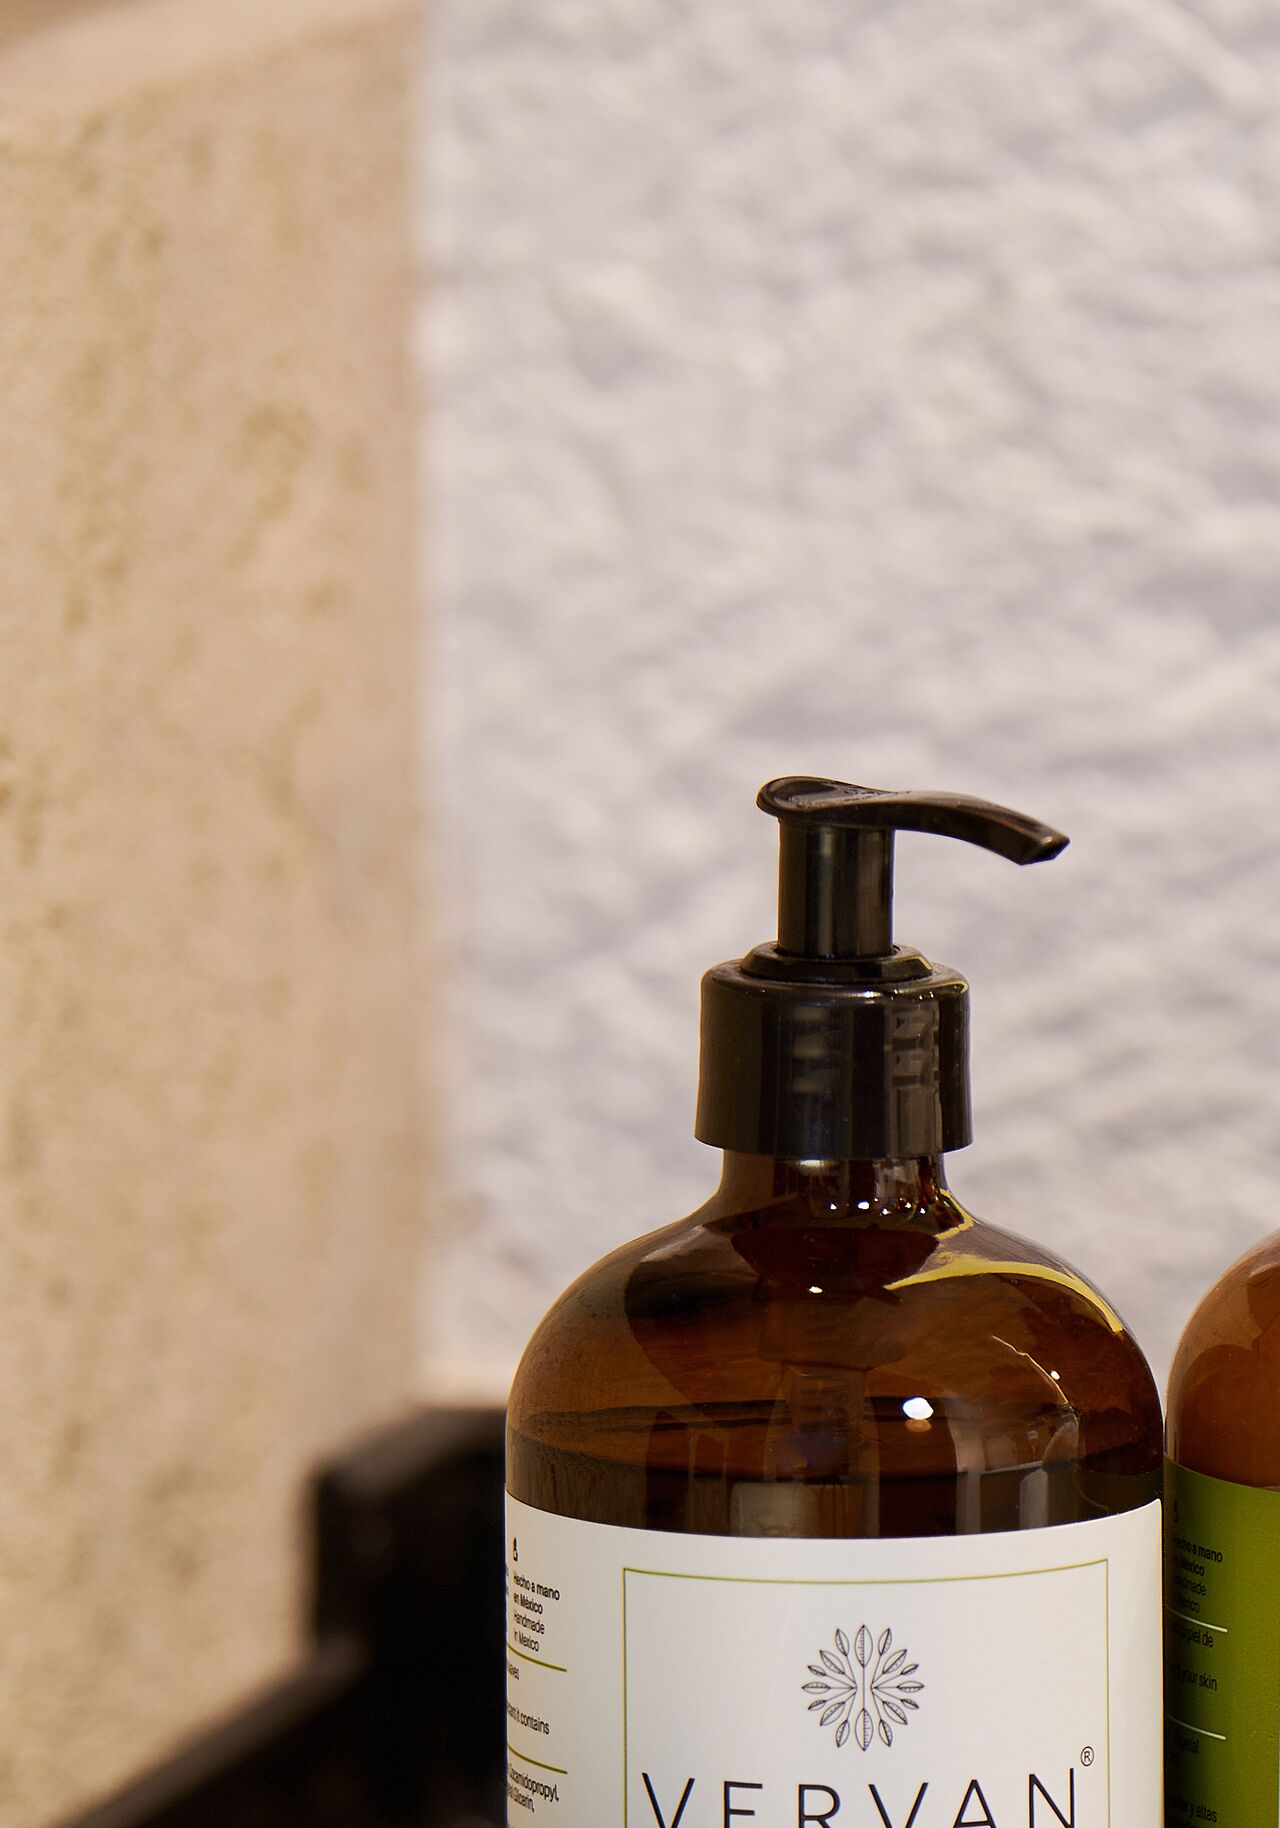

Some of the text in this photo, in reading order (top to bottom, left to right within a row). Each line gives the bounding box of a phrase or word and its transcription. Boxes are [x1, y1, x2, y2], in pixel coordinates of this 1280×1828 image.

[1198, 1546, 1223, 1564] mano
[536, 1584, 560, 1601] mano
[1202, 1631, 1214, 1648] de
[1199, 1671, 1218, 1692] skin
[520, 1712, 550, 1735] contains
[1196, 1803, 1218, 1823] altas
